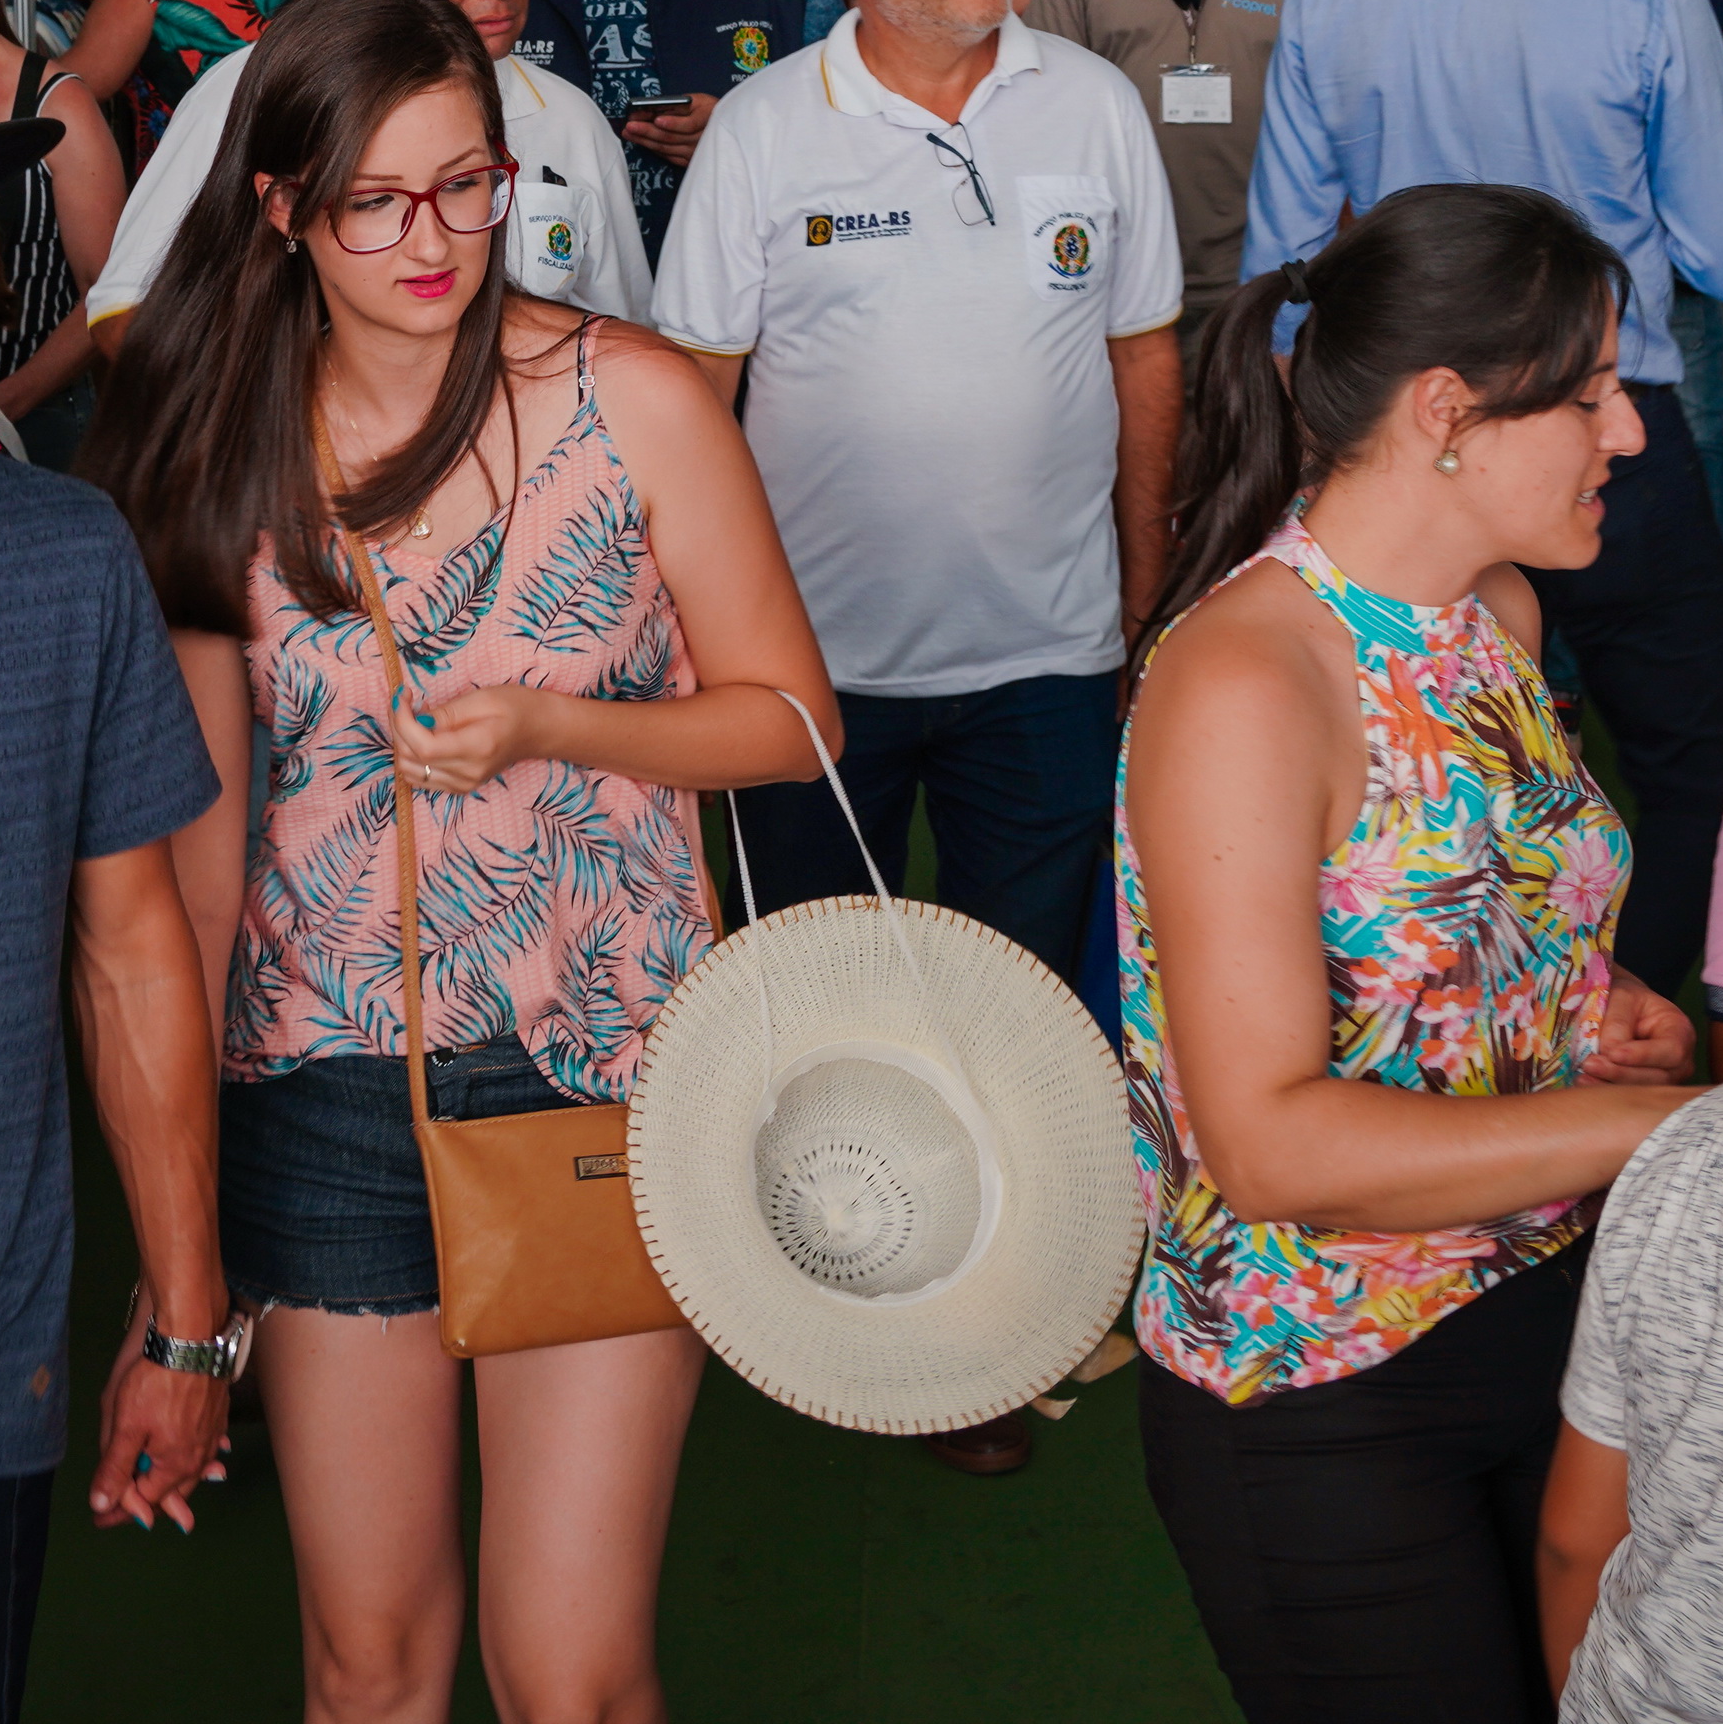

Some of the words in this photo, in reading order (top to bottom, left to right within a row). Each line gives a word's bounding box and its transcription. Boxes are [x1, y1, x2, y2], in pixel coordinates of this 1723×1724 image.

[585, 1, 648, 19] OHN
[528, 215, 553, 224] SERVIÇO
[835, 211, 911, 232] CREA-RS
